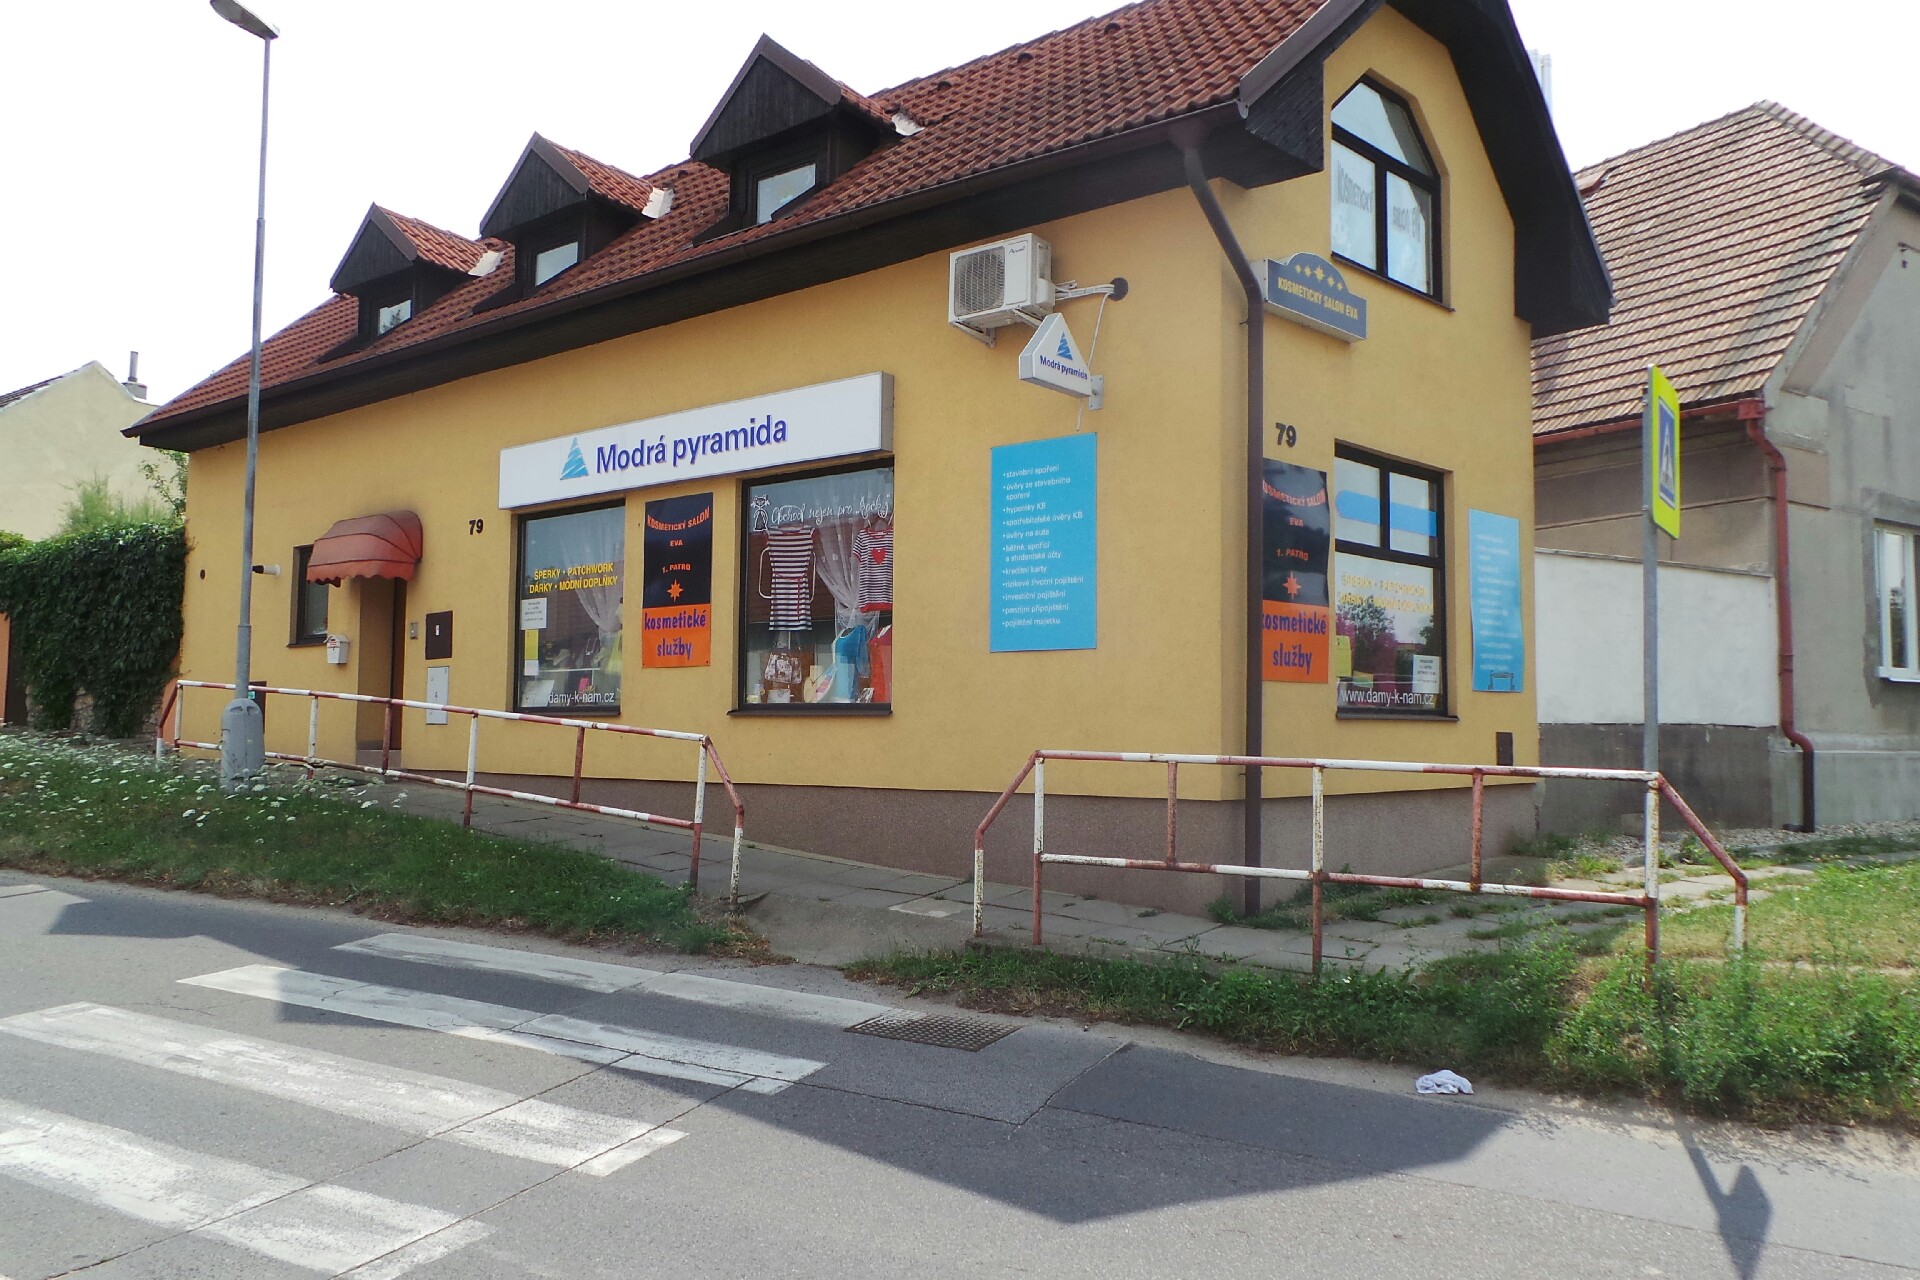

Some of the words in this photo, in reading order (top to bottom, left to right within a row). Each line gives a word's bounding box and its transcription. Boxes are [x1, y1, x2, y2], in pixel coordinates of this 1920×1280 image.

[1277, 276, 1323, 305] KOSMETICKÝ
[1323, 295, 1345, 314] SALON
[1345, 304, 1359, 321] EVA
[1040, 355, 1061, 371] Modrá
[1061, 364, 1088, 380] pyramida
[596, 434, 667, 475] Modrá
[672, 414, 788, 468] pyramida
[1275, 422, 1297, 448] 79
[1263, 480, 1305, 507] OSMETICKÝ
[837, 504, 853, 520] pro
[1036, 502, 1047, 510] KB
[1073, 511, 1083, 519] KB
[469, 518, 484, 536] 79
[647, 514, 687, 531] KOSMETICKÝ
[687, 505, 710, 528] SALON
[1289, 517, 1304, 527] EVA
[669, 539, 684, 547] EVA
[1276, 548, 1284, 557] 1.
[1286, 548, 1309, 561] PATRO
[534, 568, 561, 581] ŠPERKY
[567, 562, 614, 577] PATCHWORK
[662, 565, 669, 574] 1.
[669, 563, 691, 571] PATRO
[529, 580, 553, 594] DÁRKY
[559, 577, 582, 591] MÓDNÍ
[583, 574, 618, 589] DOPLŇKY
[644, 609, 707, 630] kosmetické
[1262, 611, 1327, 635] osmetické
[657, 636, 693, 660] služby
[1272, 642, 1313, 675] služby
[1342, 688, 1434, 707] www.damy-k-nam.cz
